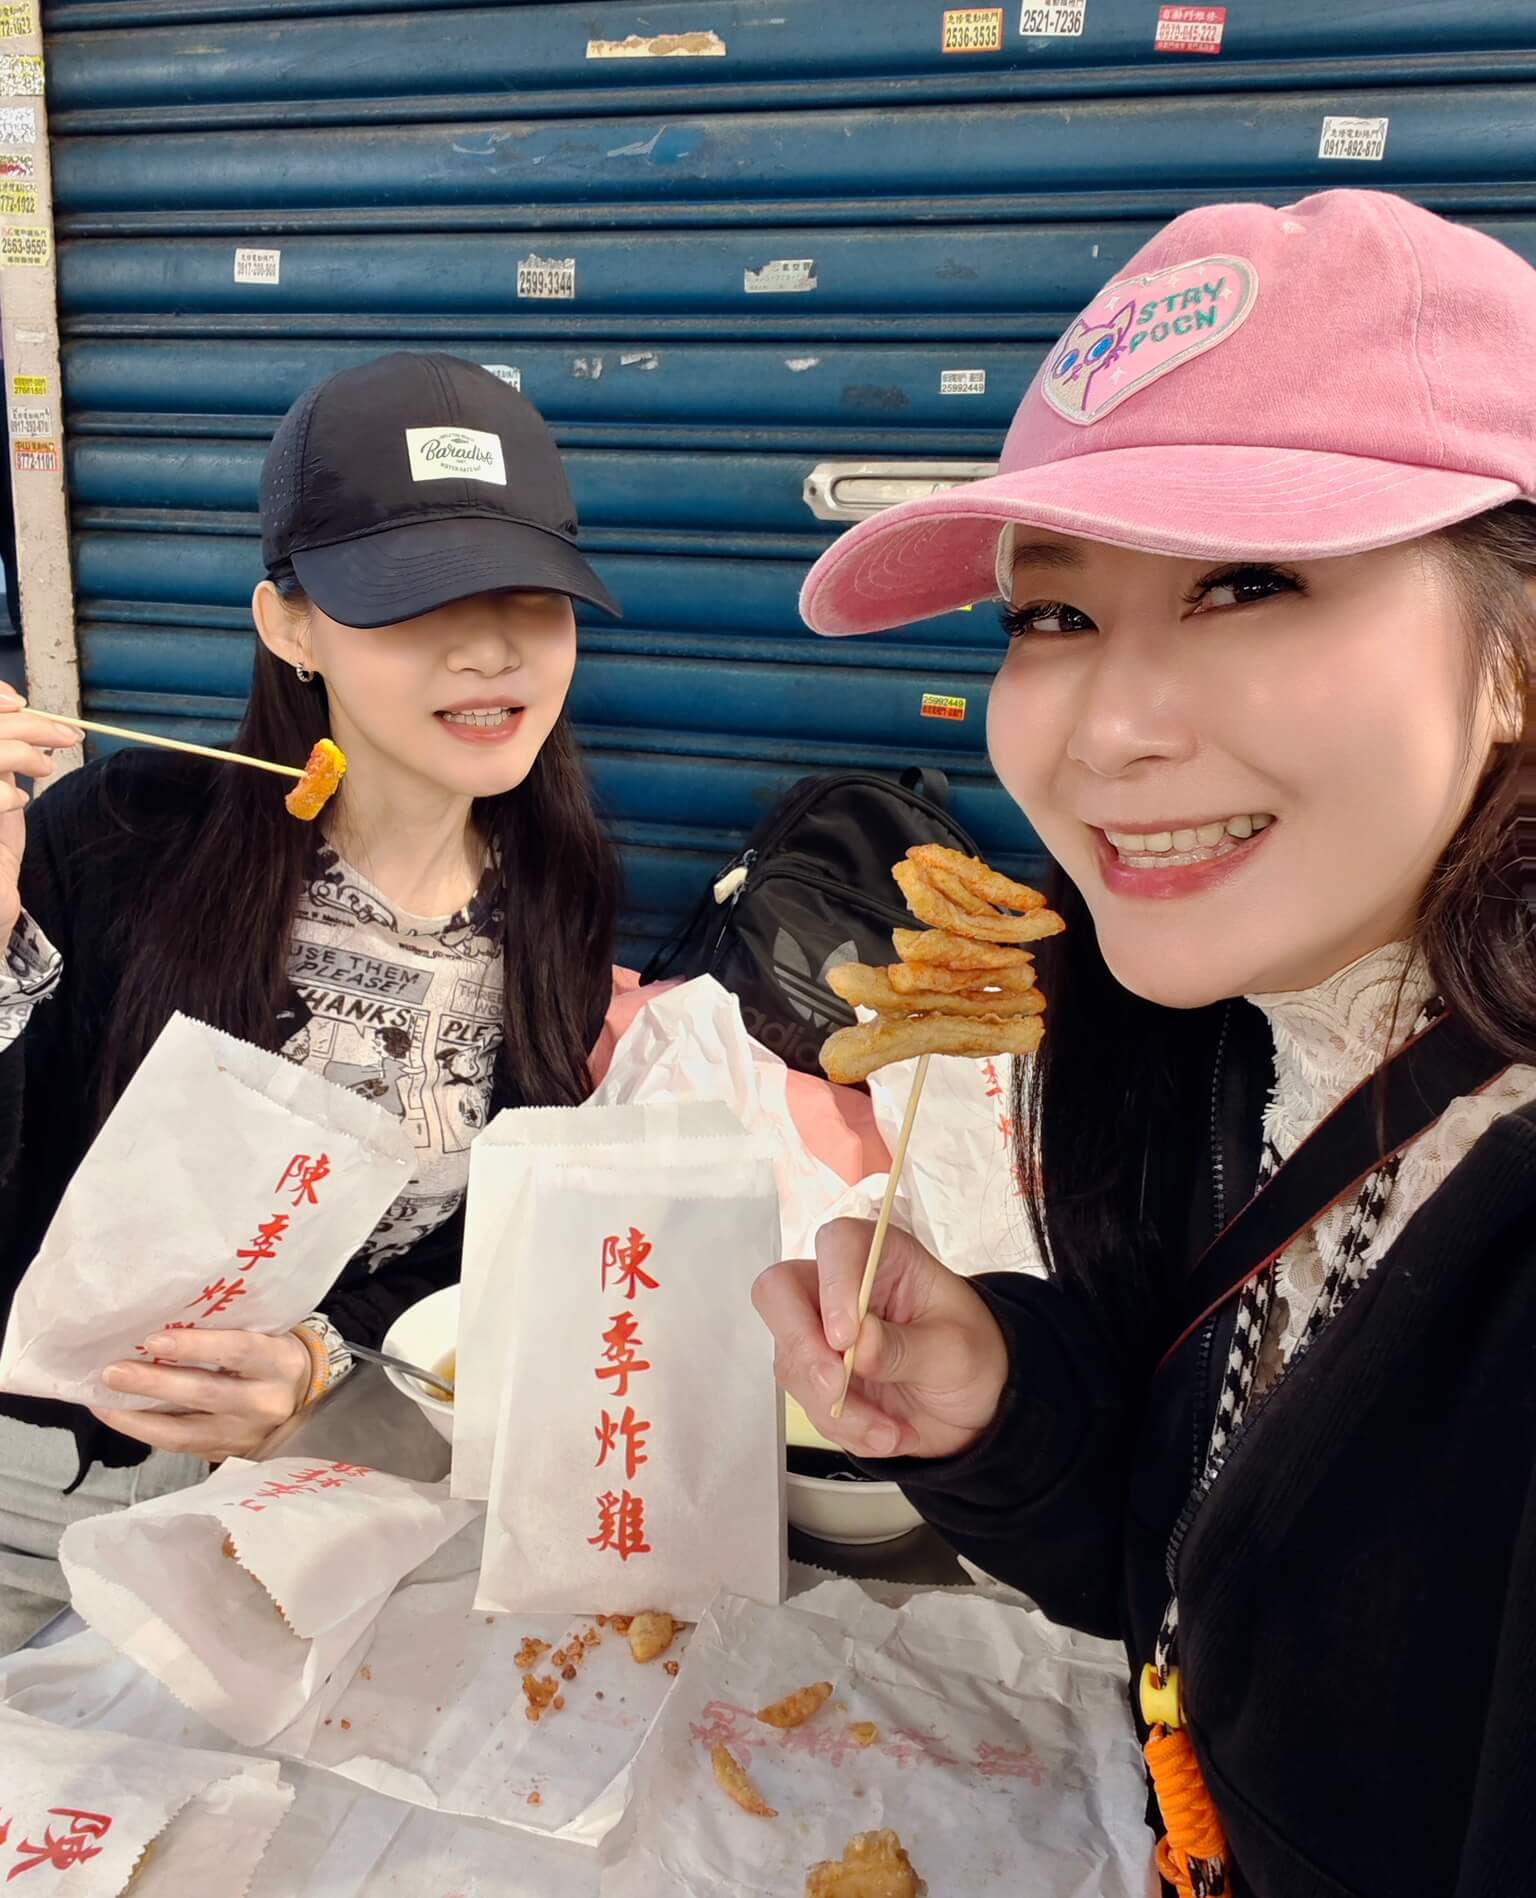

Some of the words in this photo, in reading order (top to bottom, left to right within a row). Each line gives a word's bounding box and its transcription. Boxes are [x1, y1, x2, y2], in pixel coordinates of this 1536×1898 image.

[1022, 9, 1082, 33] 2521-7236
[946, 25, 997, 48] 2536-3535
[520, 270, 572, 297] 2599-3344
[295, 961, 407, 994] PLEASE!
[349, 956, 420, 984] THEM
[140, 1152, 332, 1350] 陳季炸
[586, 1226, 660, 1562] 陳季炸雞
[0, 1807, 112, 1883] 陳
